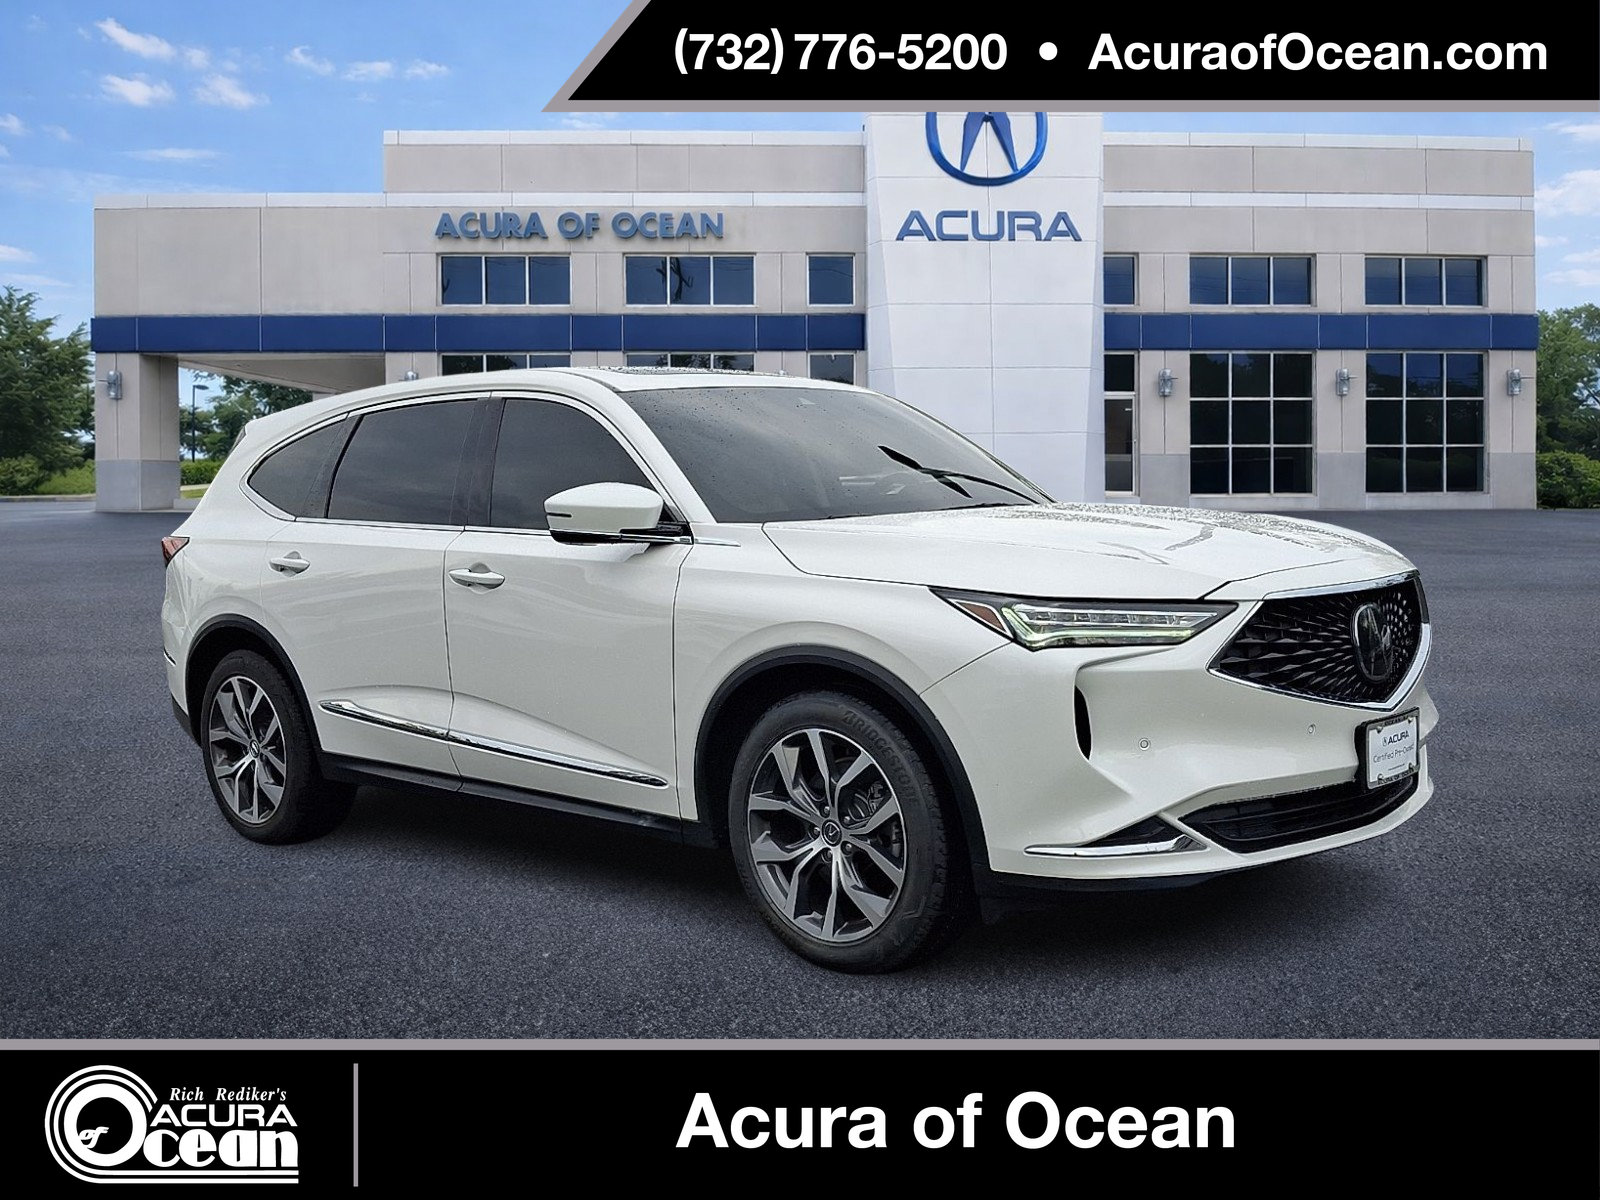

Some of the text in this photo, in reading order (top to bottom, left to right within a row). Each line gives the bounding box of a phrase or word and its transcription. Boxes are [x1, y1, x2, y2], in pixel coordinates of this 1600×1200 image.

[434, 211, 723, 240] ACURA OF OCEAN
[895, 209, 1082, 242] ACURA
[1388, 731, 1409, 745] ACURA
